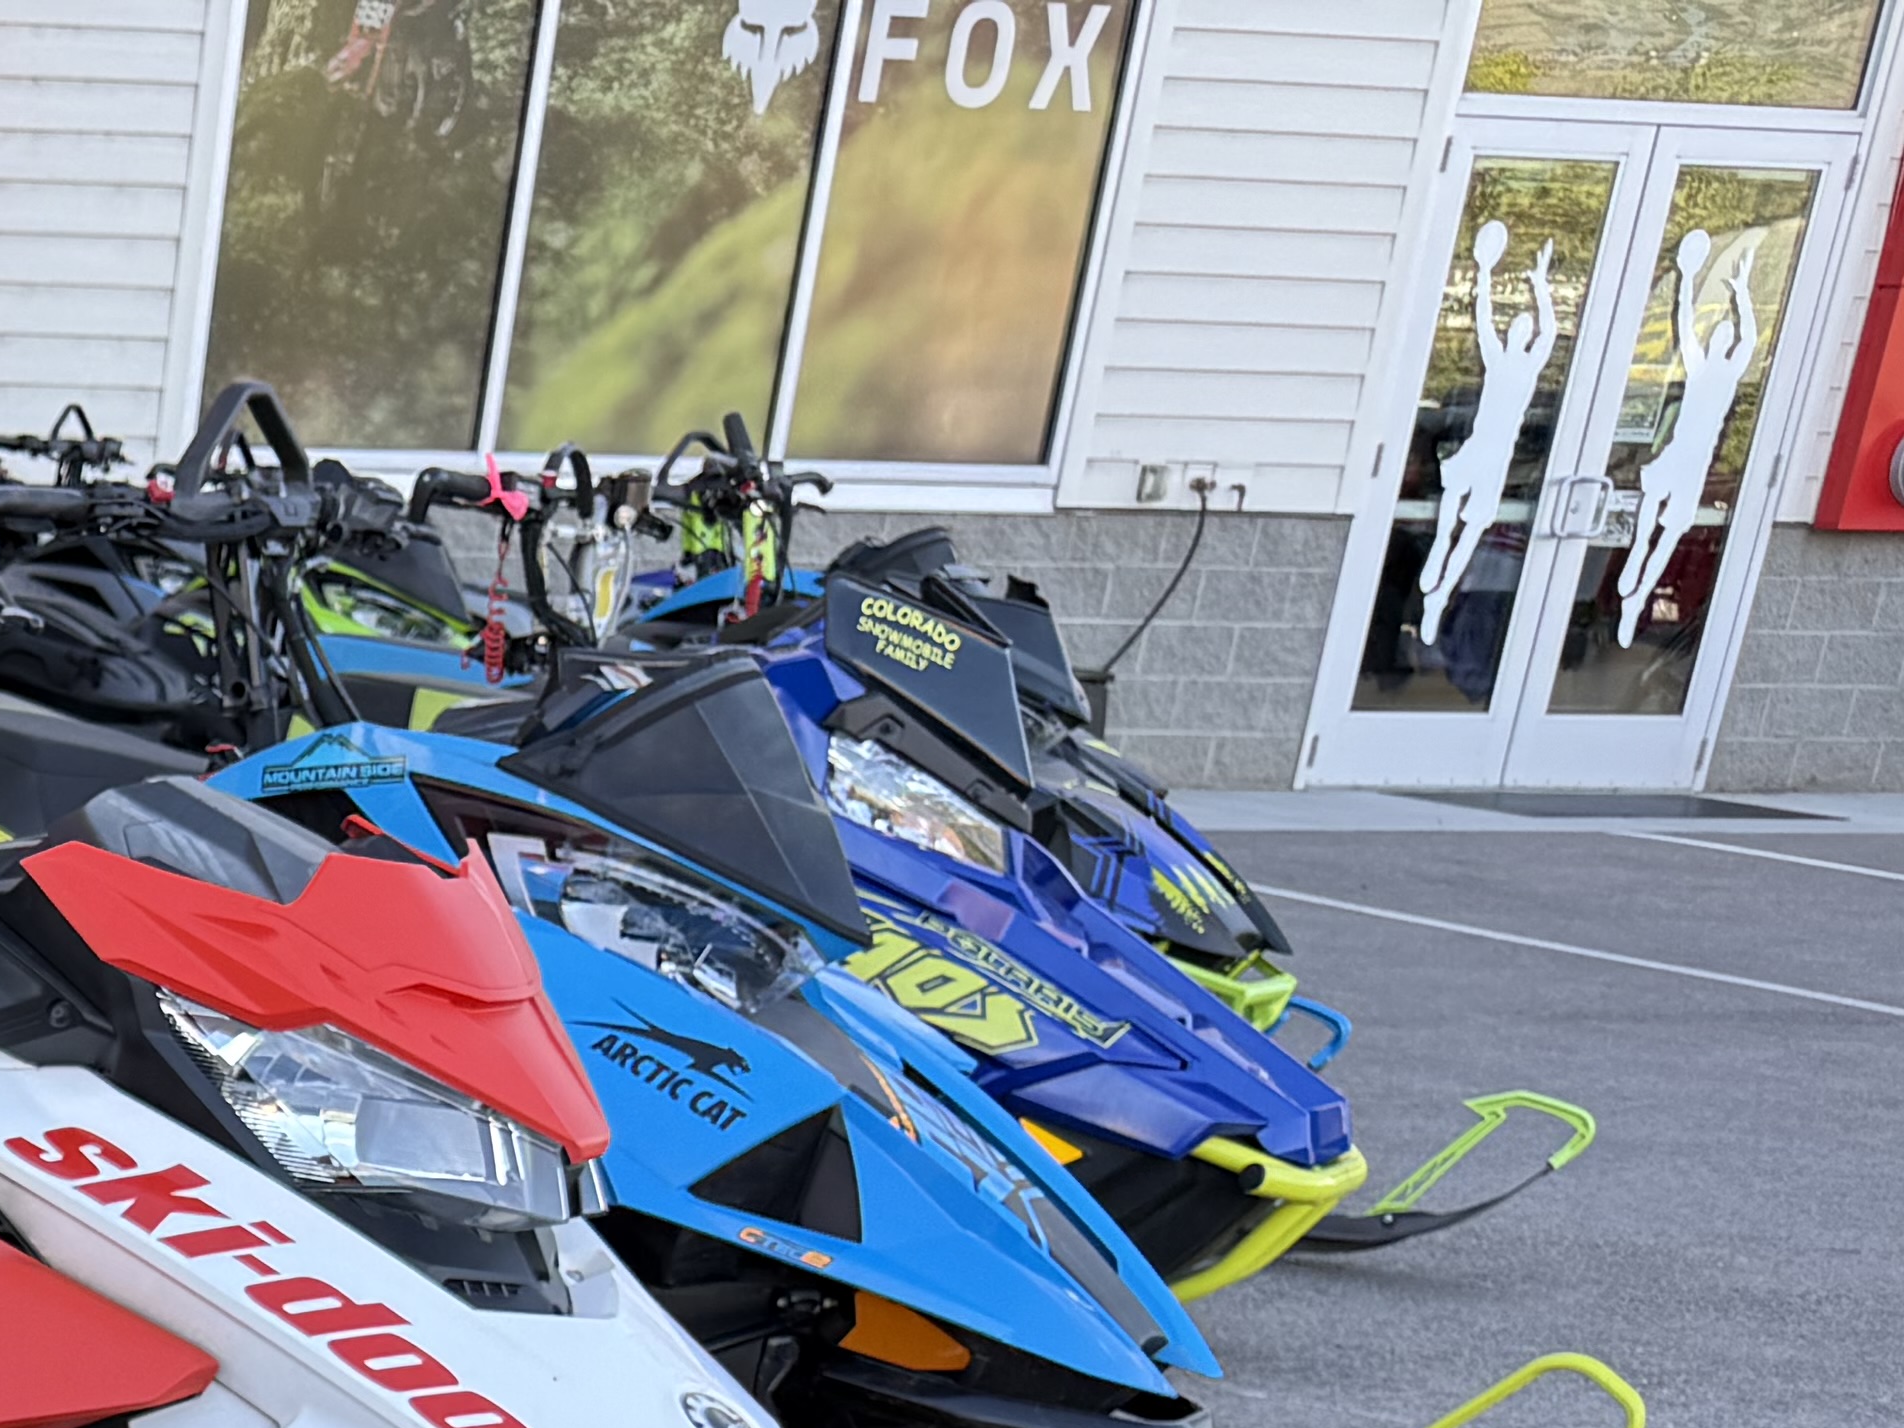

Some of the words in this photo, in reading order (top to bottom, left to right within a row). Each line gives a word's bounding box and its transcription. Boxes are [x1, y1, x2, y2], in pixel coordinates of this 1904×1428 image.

[858, 0, 1111, 112] FOX
[856, 615, 955, 670] SNOWMOBILE
[861, 597, 961, 651] COLORADO
[875, 638, 929, 671] FAMILY
[264, 766, 357, 785] MOUNTAIN
[359, 762, 404, 779] SIDE
[591, 1034, 694, 1102] ARCTIC
[689, 1090, 748, 1131] CAT
